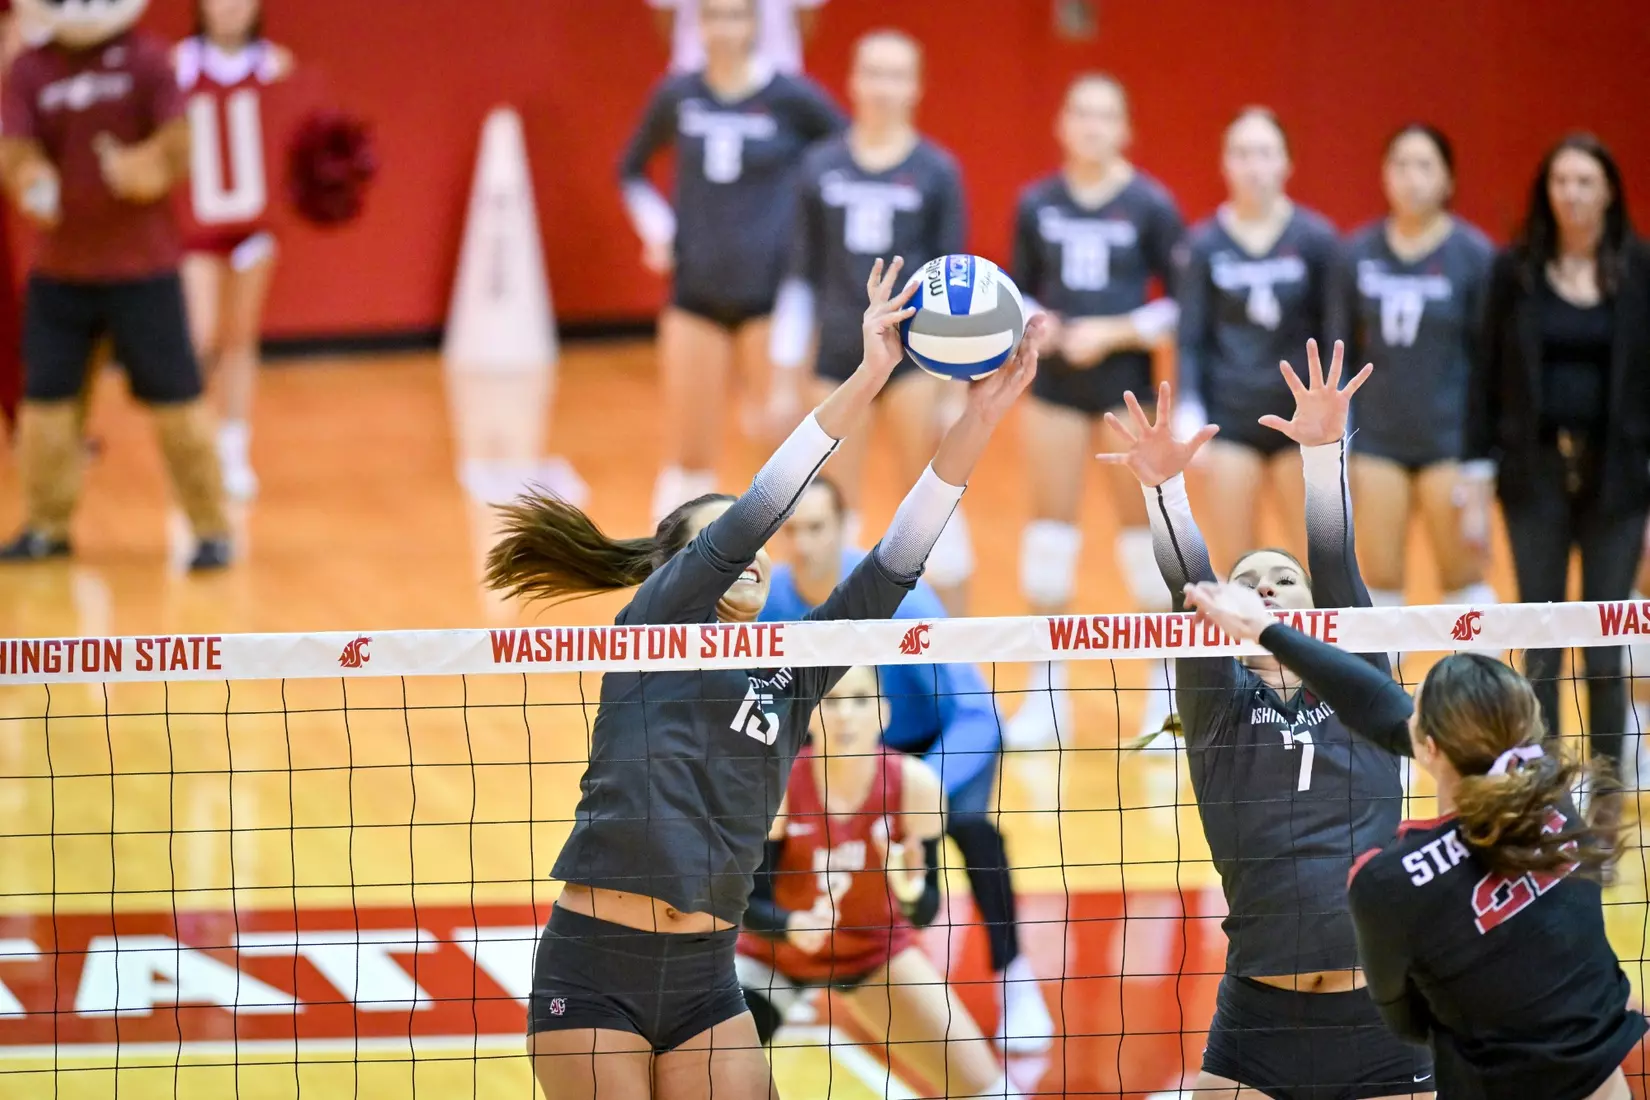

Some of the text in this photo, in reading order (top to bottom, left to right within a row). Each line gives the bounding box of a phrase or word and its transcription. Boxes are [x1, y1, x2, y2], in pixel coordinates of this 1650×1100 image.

[190, 90, 266, 223] U
[135, 636, 222, 672] STATE
[489, 623, 785, 664] WASHINGTON STATE
[730, 685, 780, 746] 15
[1279, 730, 1315, 792] 7
